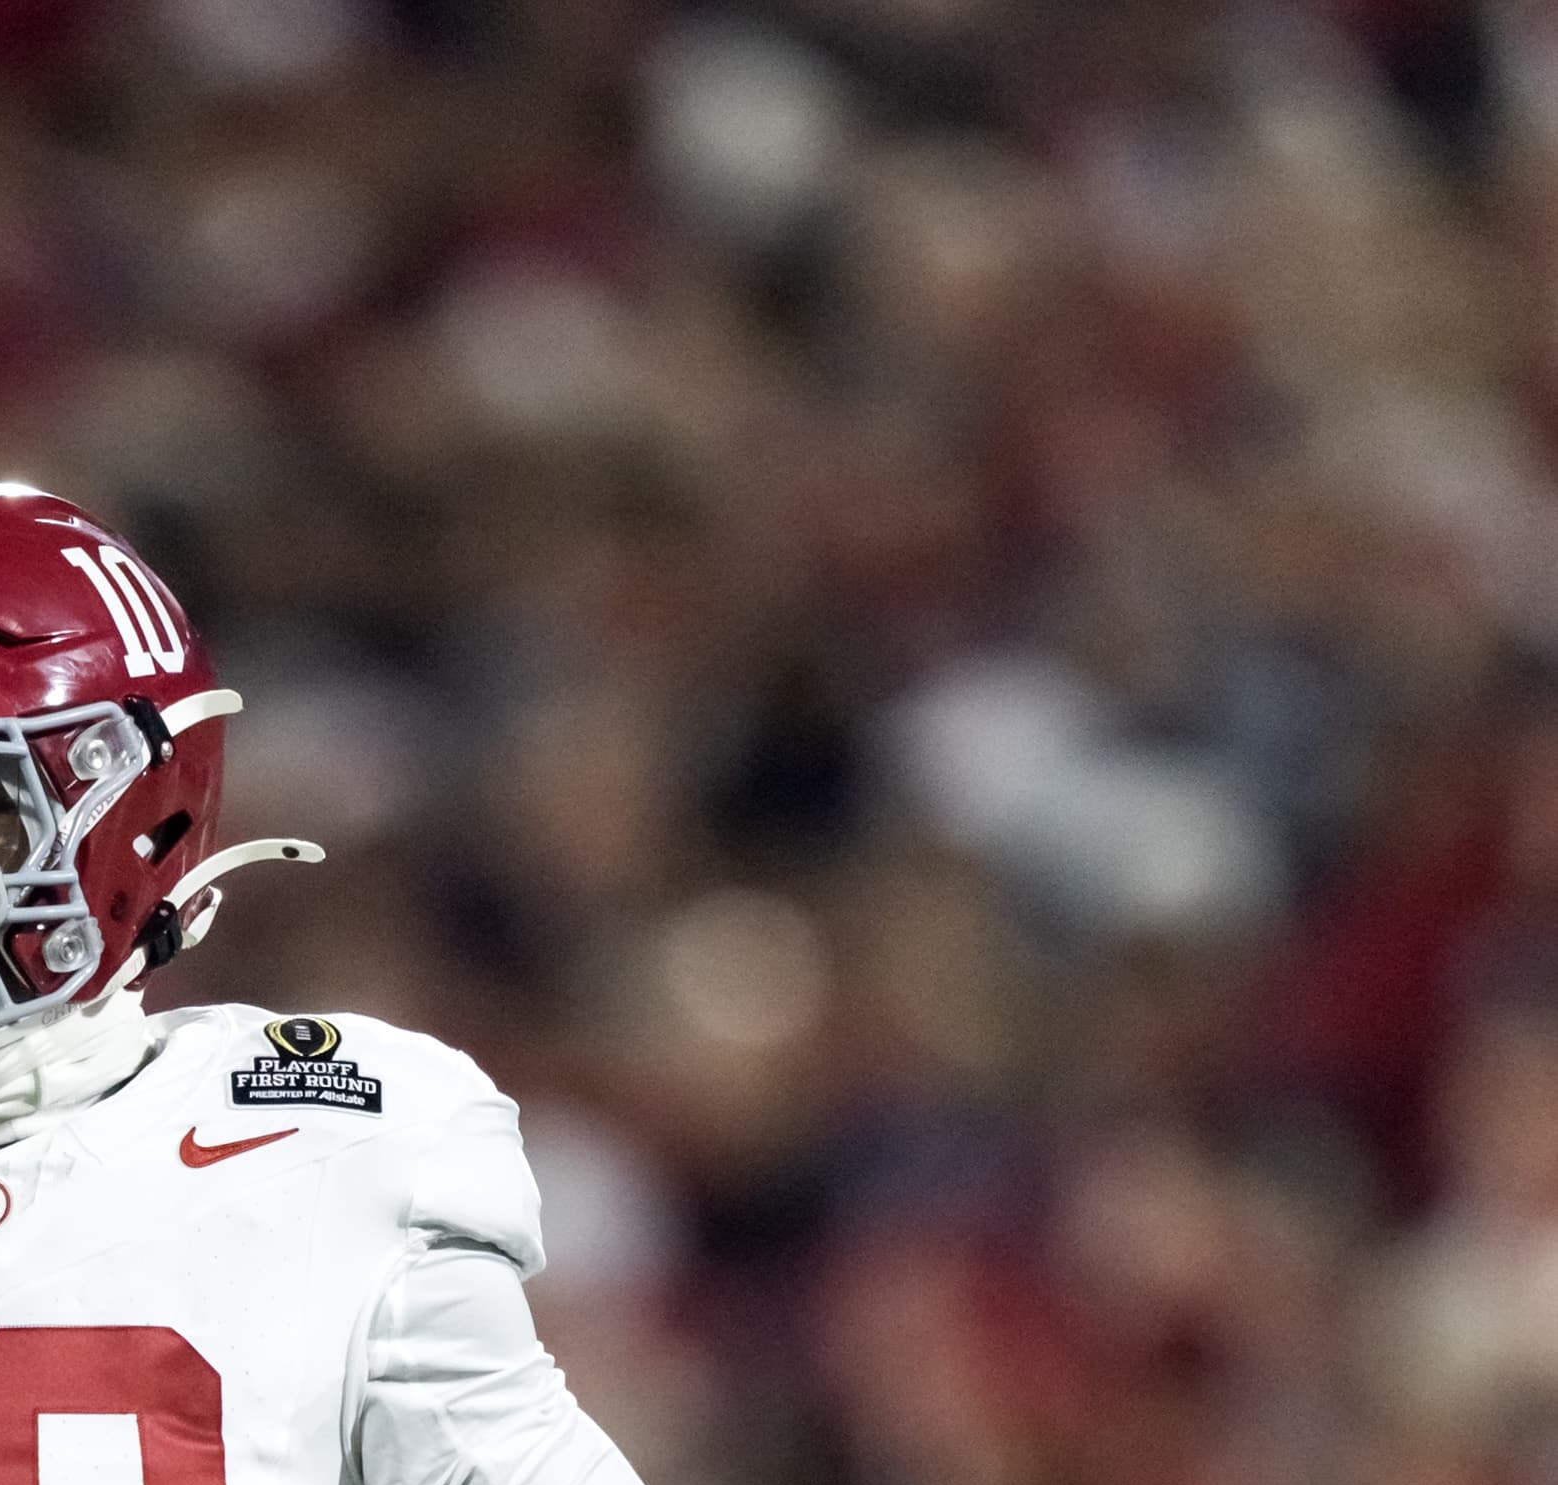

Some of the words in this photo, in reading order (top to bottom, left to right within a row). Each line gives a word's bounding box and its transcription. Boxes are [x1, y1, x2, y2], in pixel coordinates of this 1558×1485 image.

[60, 545, 185, 678] 10
[259, 1060, 353, 1076] PLAYOFF
[236, 1073, 300, 1088] FIRST
[305, 1074, 377, 1095] ROUND
[249, 1090, 304, 1099] PRESENTED
[305, 1090, 318, 1098] BY
[319, 1090, 366, 1106] Allstate
